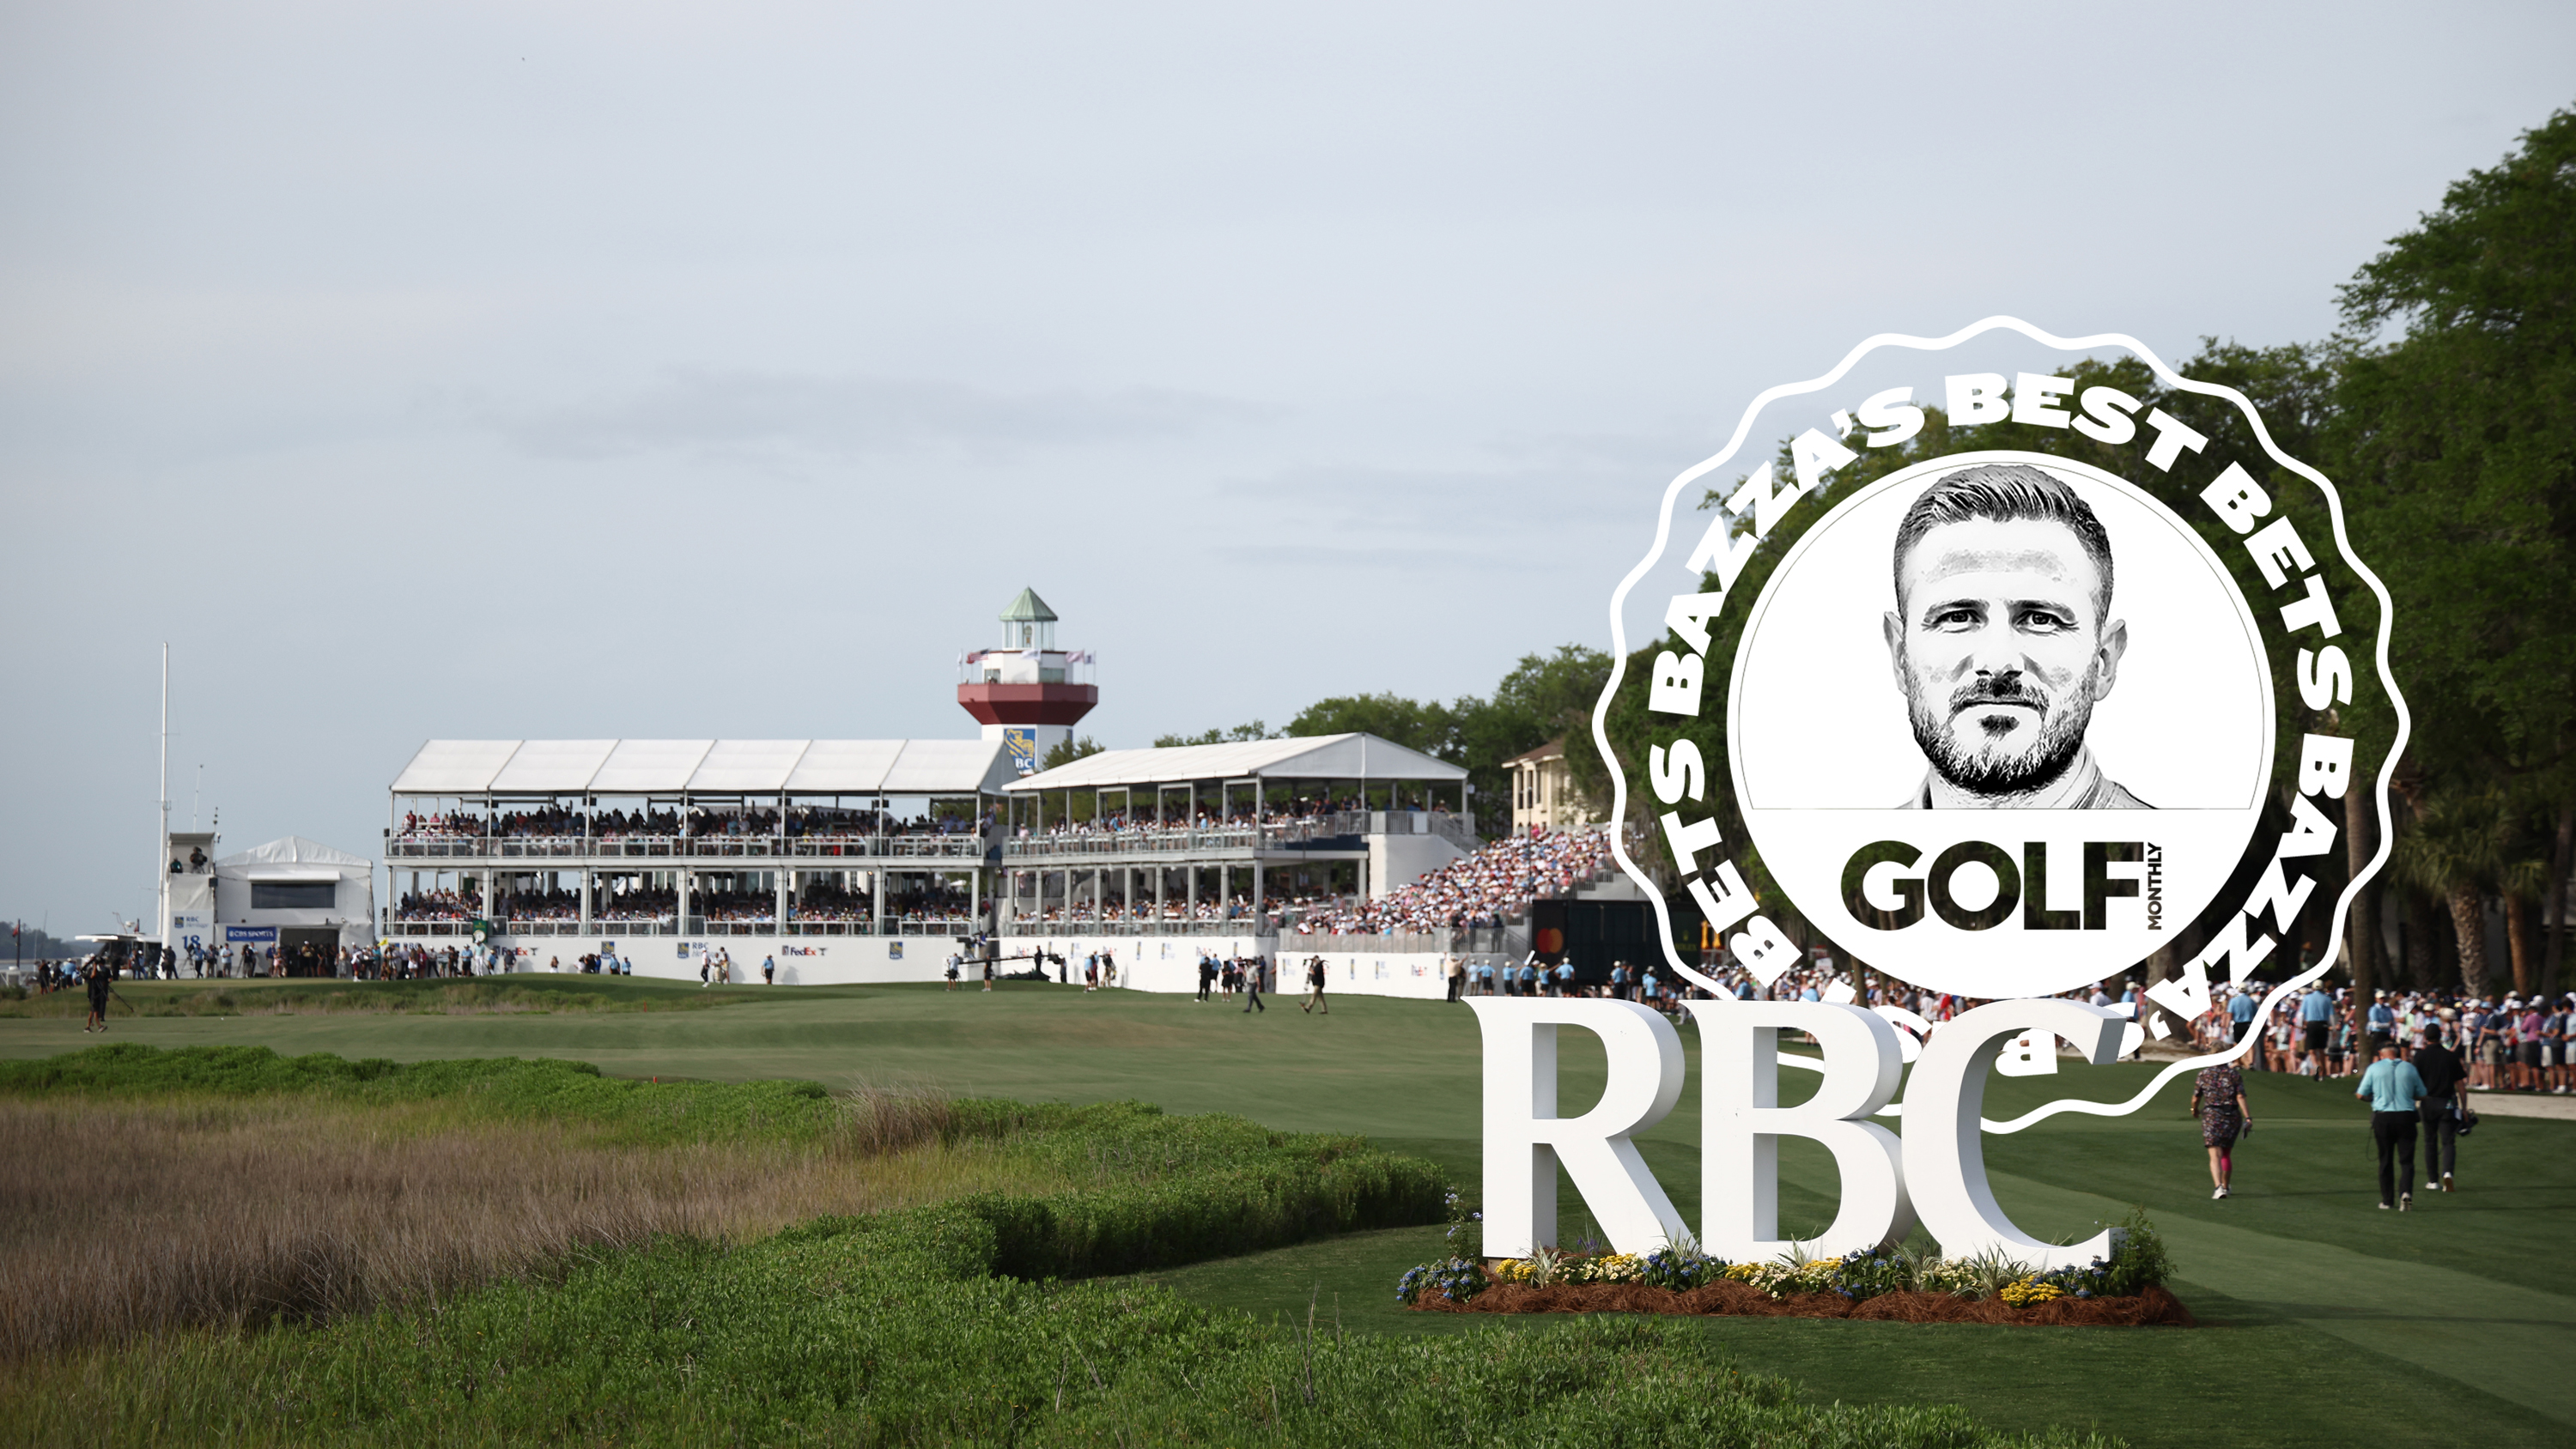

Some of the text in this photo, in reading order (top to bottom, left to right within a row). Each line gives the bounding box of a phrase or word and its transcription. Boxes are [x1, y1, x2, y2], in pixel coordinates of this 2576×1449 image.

[1015, 757, 1033, 769] BC
[181, 935, 200, 949] 18
[790, 947, 817, 956] FedEx
[1461, 997, 2128, 1269] RBC
